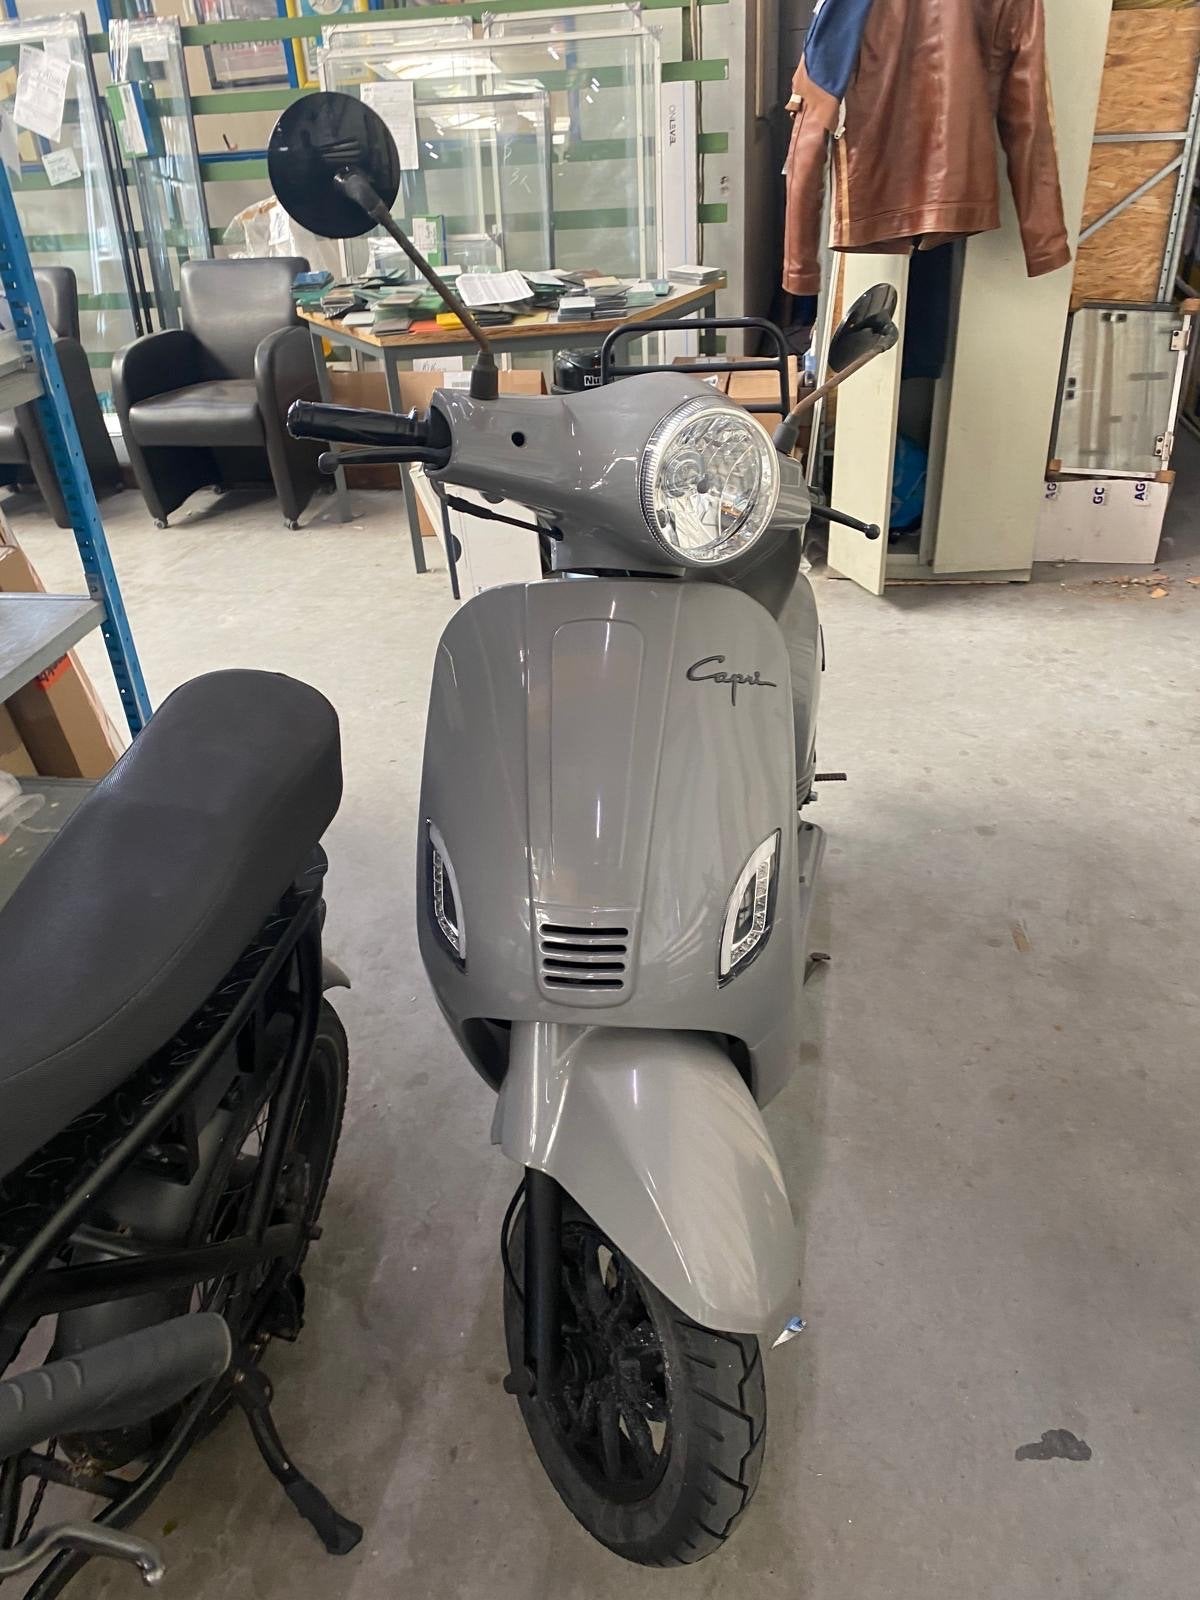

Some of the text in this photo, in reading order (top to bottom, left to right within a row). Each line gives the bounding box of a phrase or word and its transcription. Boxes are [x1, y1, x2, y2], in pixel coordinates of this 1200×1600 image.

[585, 376, 600, 385] Nu
[1045, 480, 1057, 499] AG
[1093, 487, 1105, 504] GC
[1135, 480, 1146, 501] AG
[686, 655, 777, 707] Capri
